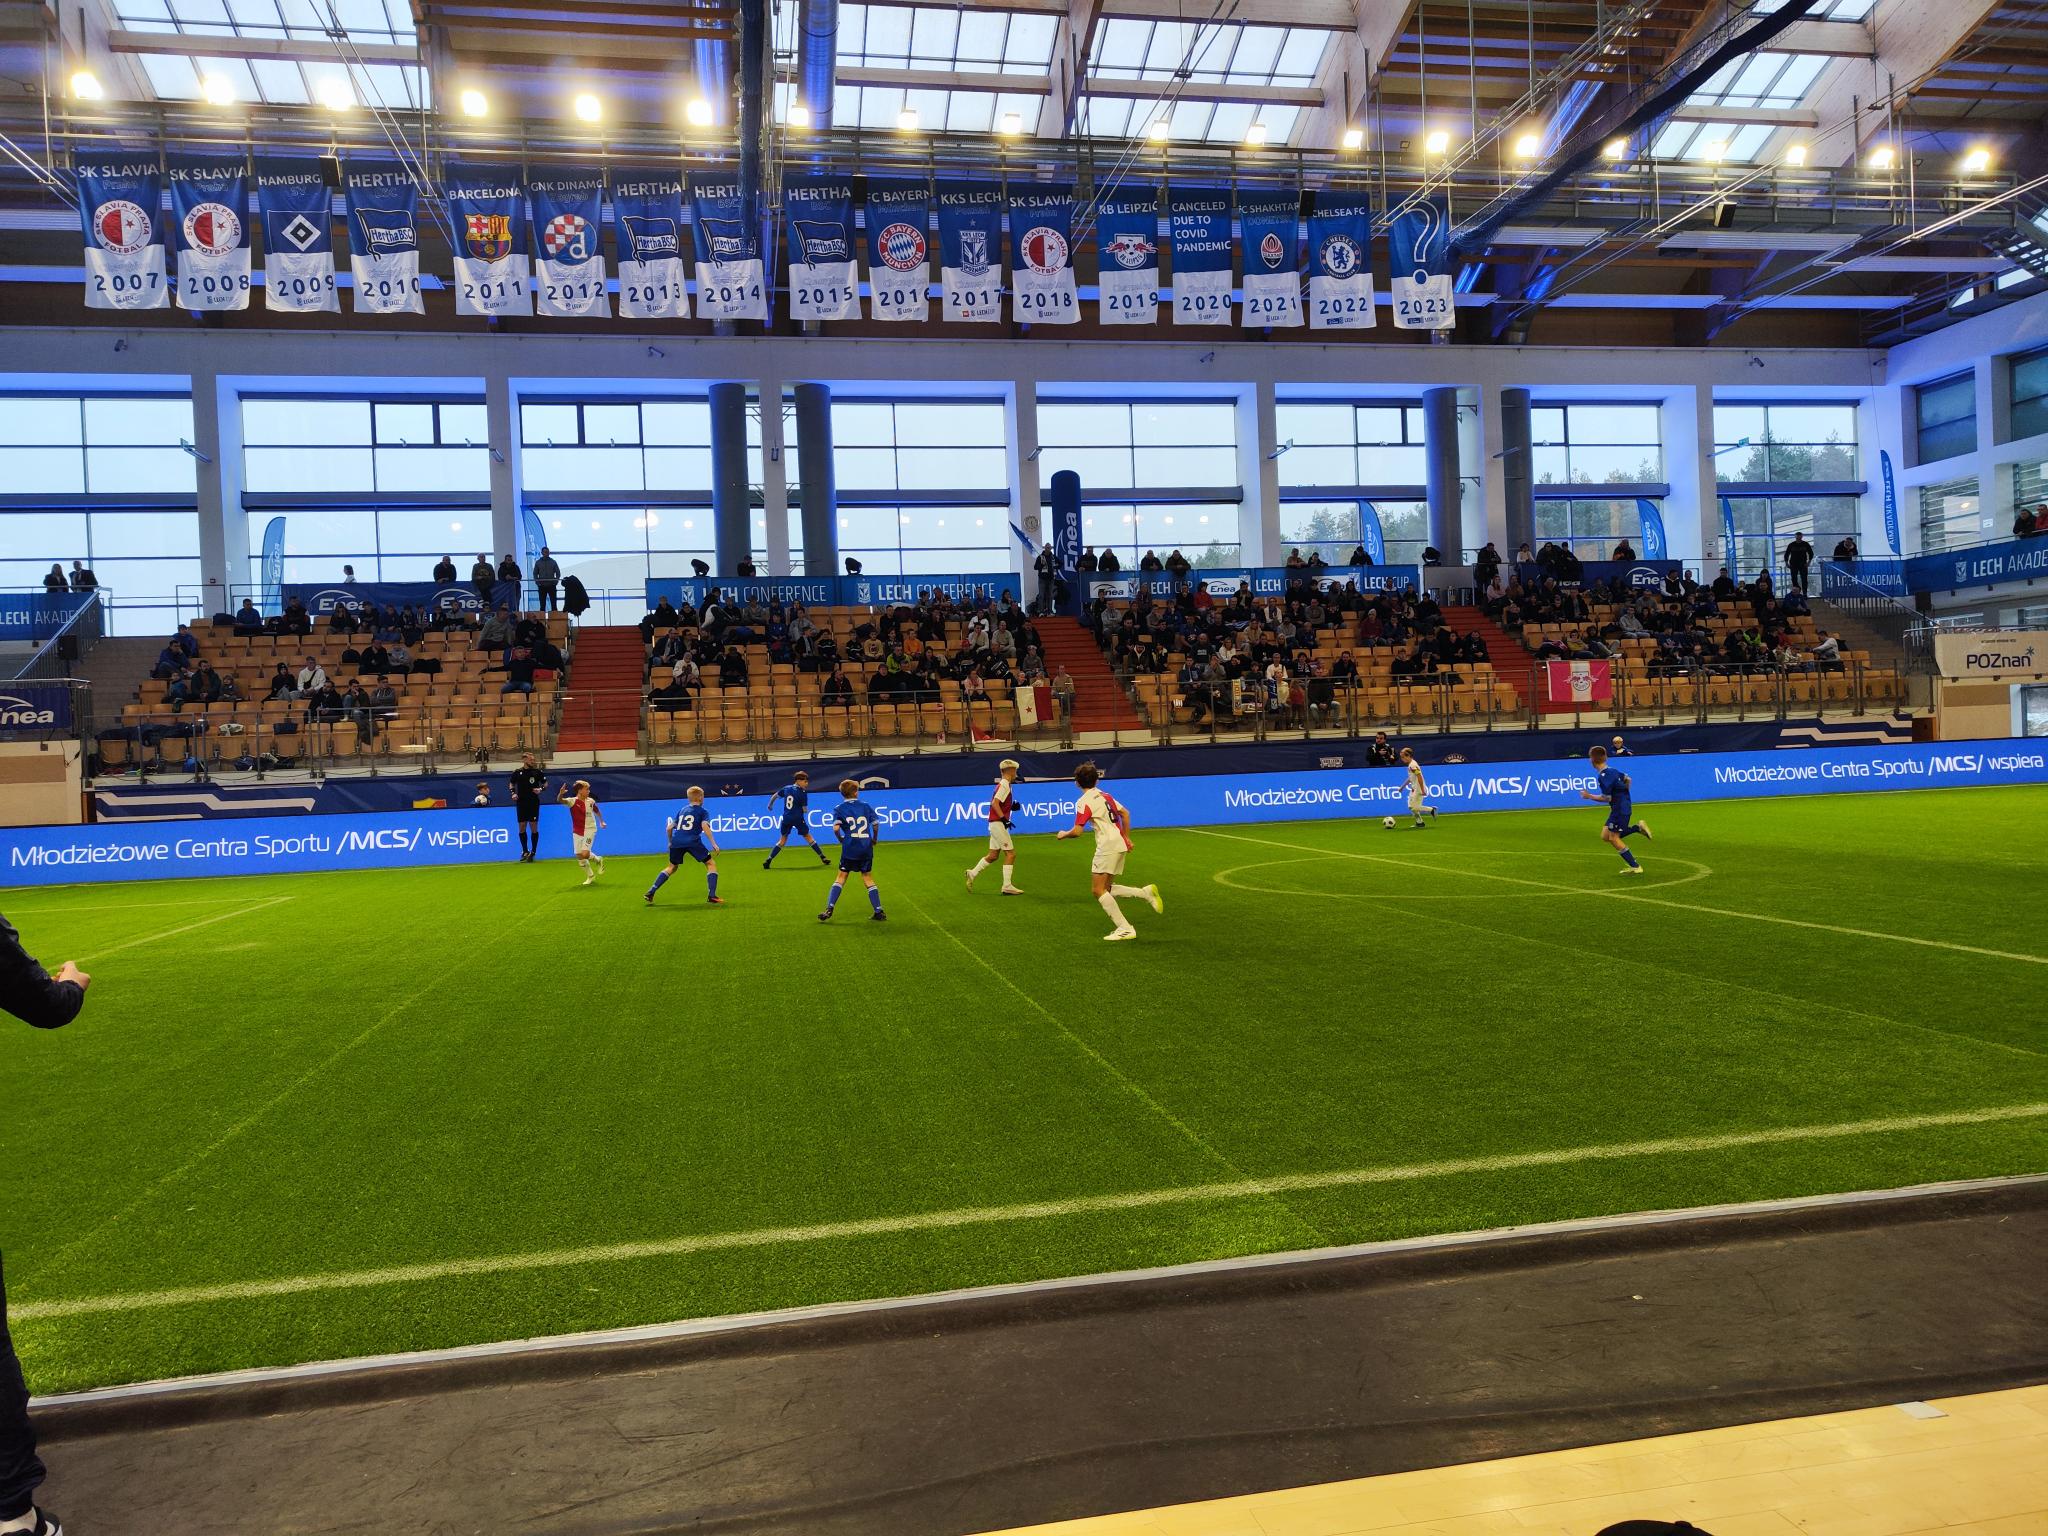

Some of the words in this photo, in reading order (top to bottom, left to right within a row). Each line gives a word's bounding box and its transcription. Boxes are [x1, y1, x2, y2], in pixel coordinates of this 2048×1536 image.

[78, 165, 98, 178] SK
[102, 163, 159, 177] SLAVIA
[170, 168, 190, 181] SK
[193, 166, 249, 181] SLAVIA
[258, 173, 321, 186] HAMBURG
[348, 172, 419, 188] HERTHA
[530, 182, 554, 192] GNK
[449, 187, 522, 200] BARCELONA
[616, 181, 682, 197] HERTHA
[694, 184, 744, 199] HERT
[788, 186, 852, 201] HERTHA
[940, 193, 966, 205] KKS
[969, 191, 1001, 204] LECH
[1009, 196, 1026, 208] SK
[1029, 194, 1073, 207] SLAVIA
[1171, 201, 1226, 212] CANCELED
[1099, 203, 1115, 215] RB
[1353, 206, 1365, 216] FC
[96, 202, 128, 220] SLAVIA
[130, 206, 150, 235] PRAHA
[188, 204, 219, 223] SLAVIA
[221, 208, 240, 237] PRAHA
[1173, 215, 1194, 226] DUE
[1197, 215, 1211, 225] TO
[881, 232, 890, 244] FC
[889, 225, 922, 244] BAYERN
[1175, 229, 1208, 239] COVID
[1326, 236, 1353, 247] CHELSEA
[104, 241, 143, 253] FOTBAL
[196, 244, 233, 255] FOTBAL
[1024, 229, 1050, 244] SLAVIA
[1051, 231, 1067, 257] PRAHA
[1177, 240, 1232, 252] PANDEMIC
[1030, 263, 1061, 274] FOTBAL
[94, 272, 159, 291] 2007
[188, 274, 250, 295] 2008
[277, 274, 334, 297] 2009
[363, 276, 420, 297] 2010
[464, 280, 522, 299] 2011
[547, 281, 604, 300] 2012
[628, 283, 681, 303] 2013
[704, 284, 760, 303] 2014
[798, 286, 853, 305] 2015
[951, 288, 1001, 307] 2017
[1021, 291, 1072, 309] 2018
[1108, 291, 1158, 310] 2019
[1182, 294, 1232, 311] 2020
[1250, 295, 1297, 314] 2021
[1319, 297, 1367, 315] 2022
[1400, 298, 1447, 315] 2023
[1064, 511, 1078, 572] Enea
[1973, 557, 2003, 578] LECH
[1150, 581, 1171, 595] ECH
[1256, 578, 1281, 592] LECH
[1632, 574, 1661, 585] Ene
[878, 584, 912, 601] LECH
[1210, 585, 1236, 593] Enea
[0, 610, 30, 625] LECH
[0, 707, 54, 725] nea
[1714, 764, 1818, 784] Młodzieżowe
[1821, 762, 1870, 779] Centra
[1872, 758, 1923, 779] Sportu
[1928, 754, 1984, 776] /MCS/
[1987, 753, 2045, 773] wspiera
[1225, 787, 1343, 808] Młodzieżowe
[1347, 783, 1402, 802] Centra
[1468, 775, 1531, 799] /MCS/
[1535, 774, 1598, 795] wspiera
[785, 795, 794, 810] 8
[676, 814, 695, 831] 13
[875, 804, 939, 827] Sportu
[845, 816, 870, 839] 22
[11, 843, 169, 867] Młodzieżowe
[175, 836, 248, 859] Centra
[254, 832, 330, 859] Sportu
[335, 827, 423, 855] /MCS/
[427, 825, 509, 849] wspiera
